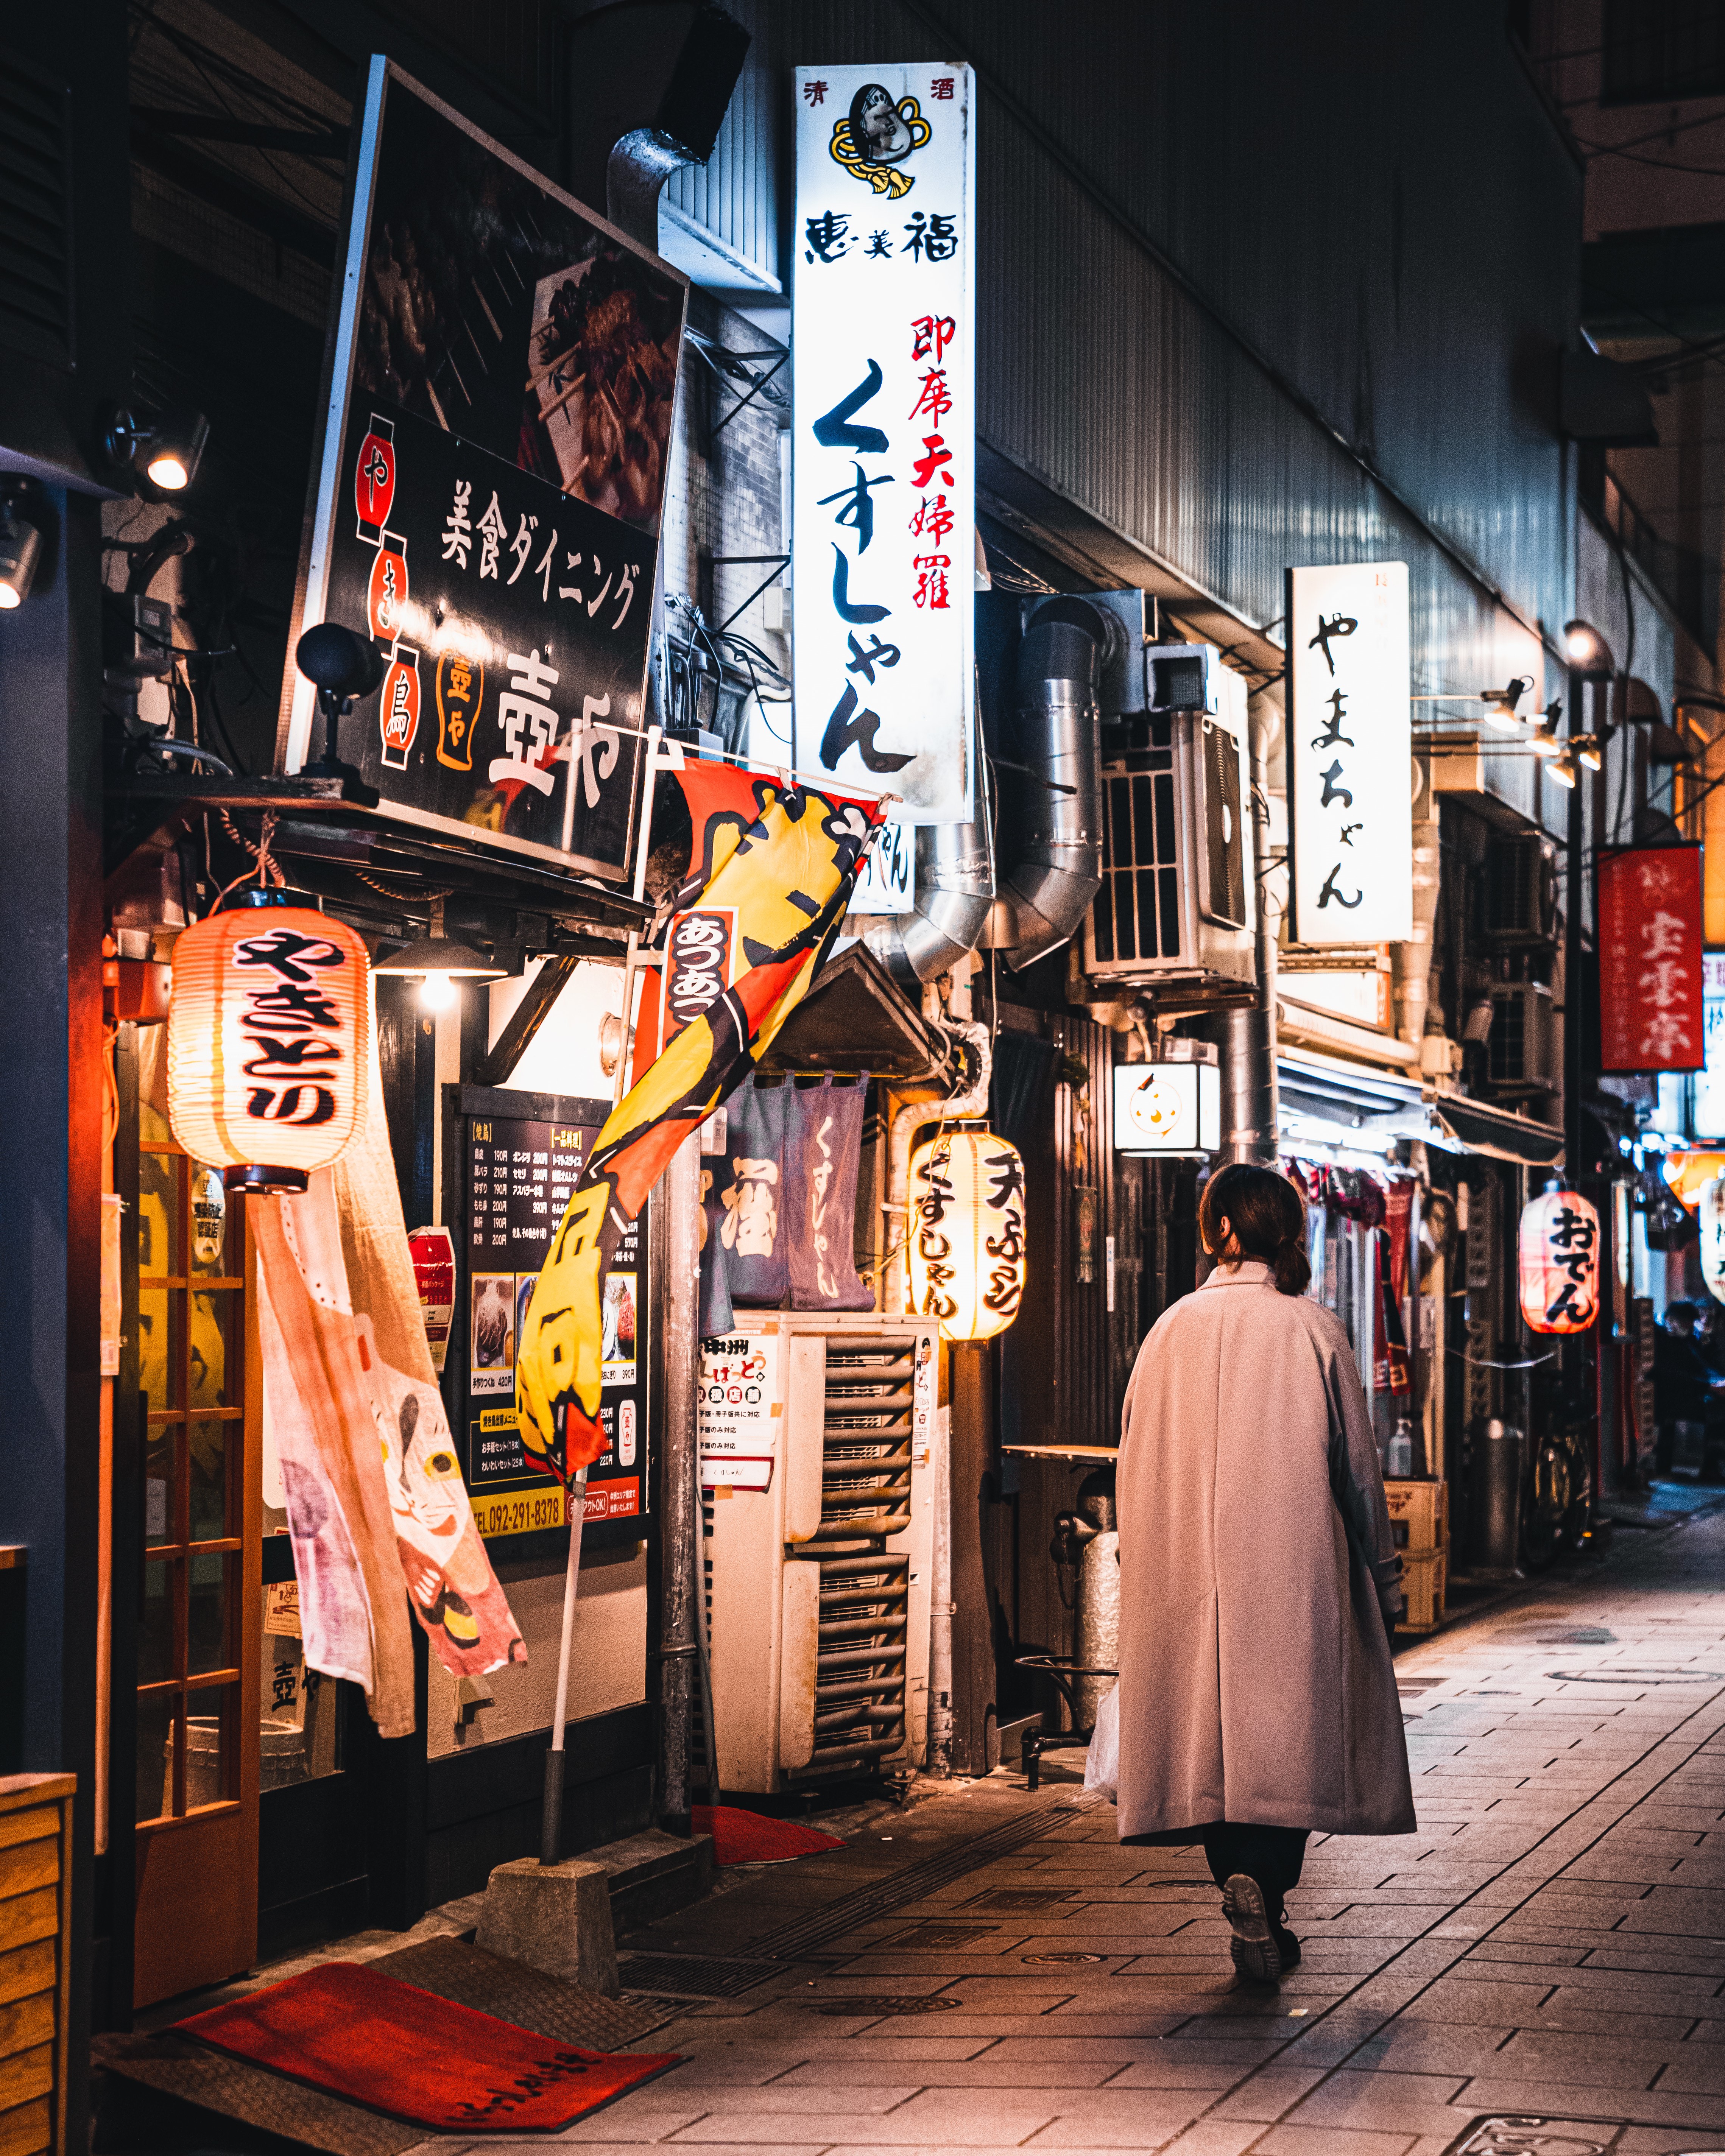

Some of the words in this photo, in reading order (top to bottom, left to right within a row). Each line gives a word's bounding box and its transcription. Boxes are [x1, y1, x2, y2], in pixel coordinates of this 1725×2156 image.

[803, 80, 829, 107] 清
[930, 78, 955, 100] 酒
[442, 479, 640, 629] 美食ダイニング
[812, 358, 916, 773] くすしゃん
[1309, 613, 1363, 908] やまちゃん
[673, 917, 723, 1022] あつあつ
[237, 931, 346, 1126] やきとり
[494, 1150, 508, 1162] 190円
[533, 1152, 548, 1165] 200円
[494, 1167, 507, 1178] 210円
[513, 1168, 526, 1179] セセリ
[533, 1169, 548, 1181] 200円
[494, 1184, 507, 1195] 190円
[492, 1201, 507, 1212] 200円
[533, 1202, 547, 1214] 390円
[812, 1116, 839, 1298] くすしゃん
[493, 1217, 506, 1229] 190円
[492, 1234, 506, 1246] 200円
[625, 1237, 639, 1248] 570円
[916, 1153, 958, 1320] くすしゃん
[1546, 1207, 1597, 1323] おでん
[622, 1369, 634, 1379] 390円
[498, 1376, 512, 1387] 420円
[600, 1407, 613, 1419] 230円
[600, 1455, 613, 1466] 220円
